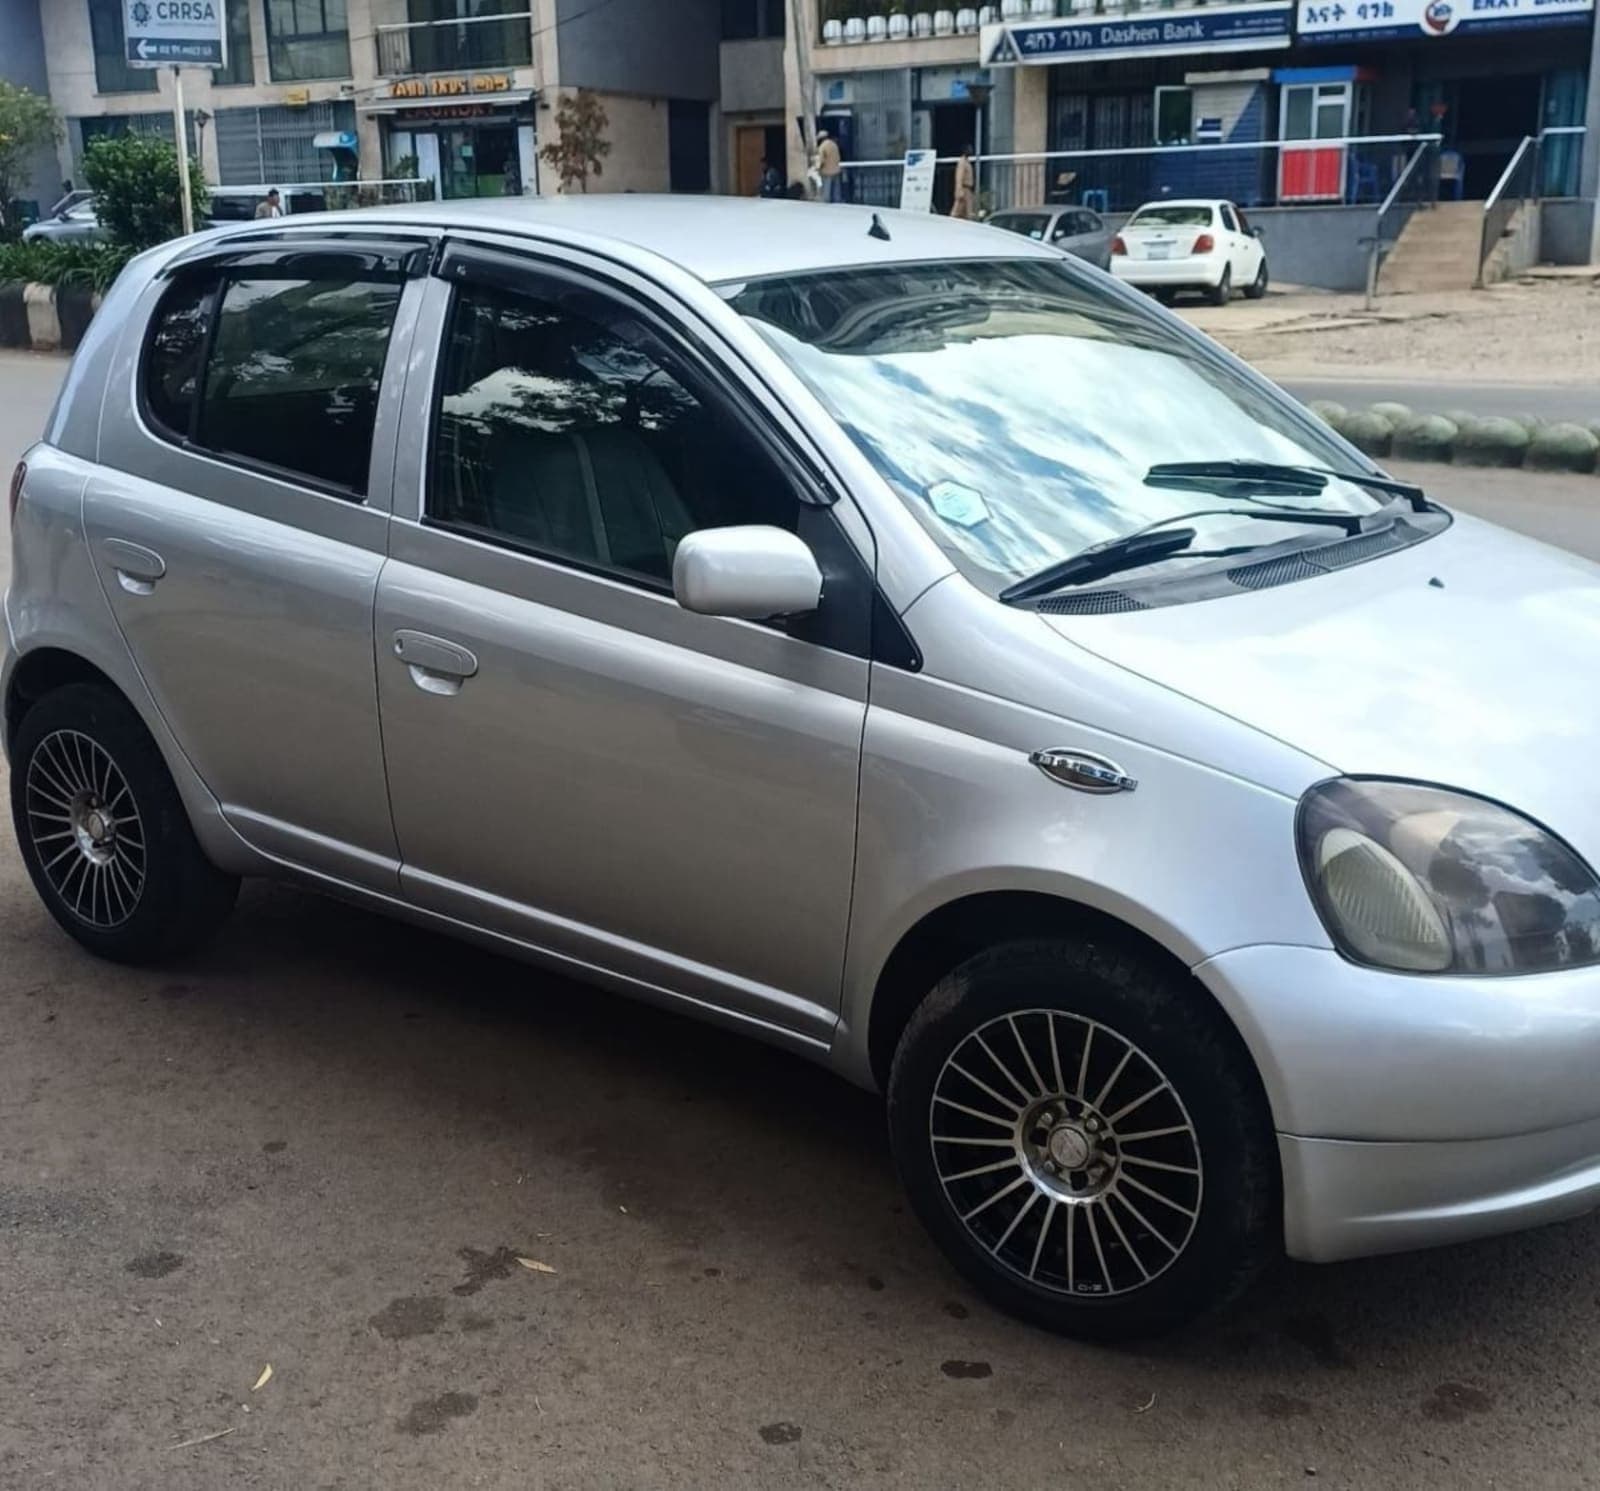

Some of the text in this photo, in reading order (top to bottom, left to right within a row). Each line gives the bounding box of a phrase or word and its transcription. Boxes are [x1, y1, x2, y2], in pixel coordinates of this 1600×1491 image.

[156, 2, 215, 20] CRRSA
[1100, 25, 1160, 44] Dashen
[1163, 20, 1205, 40] Bank
